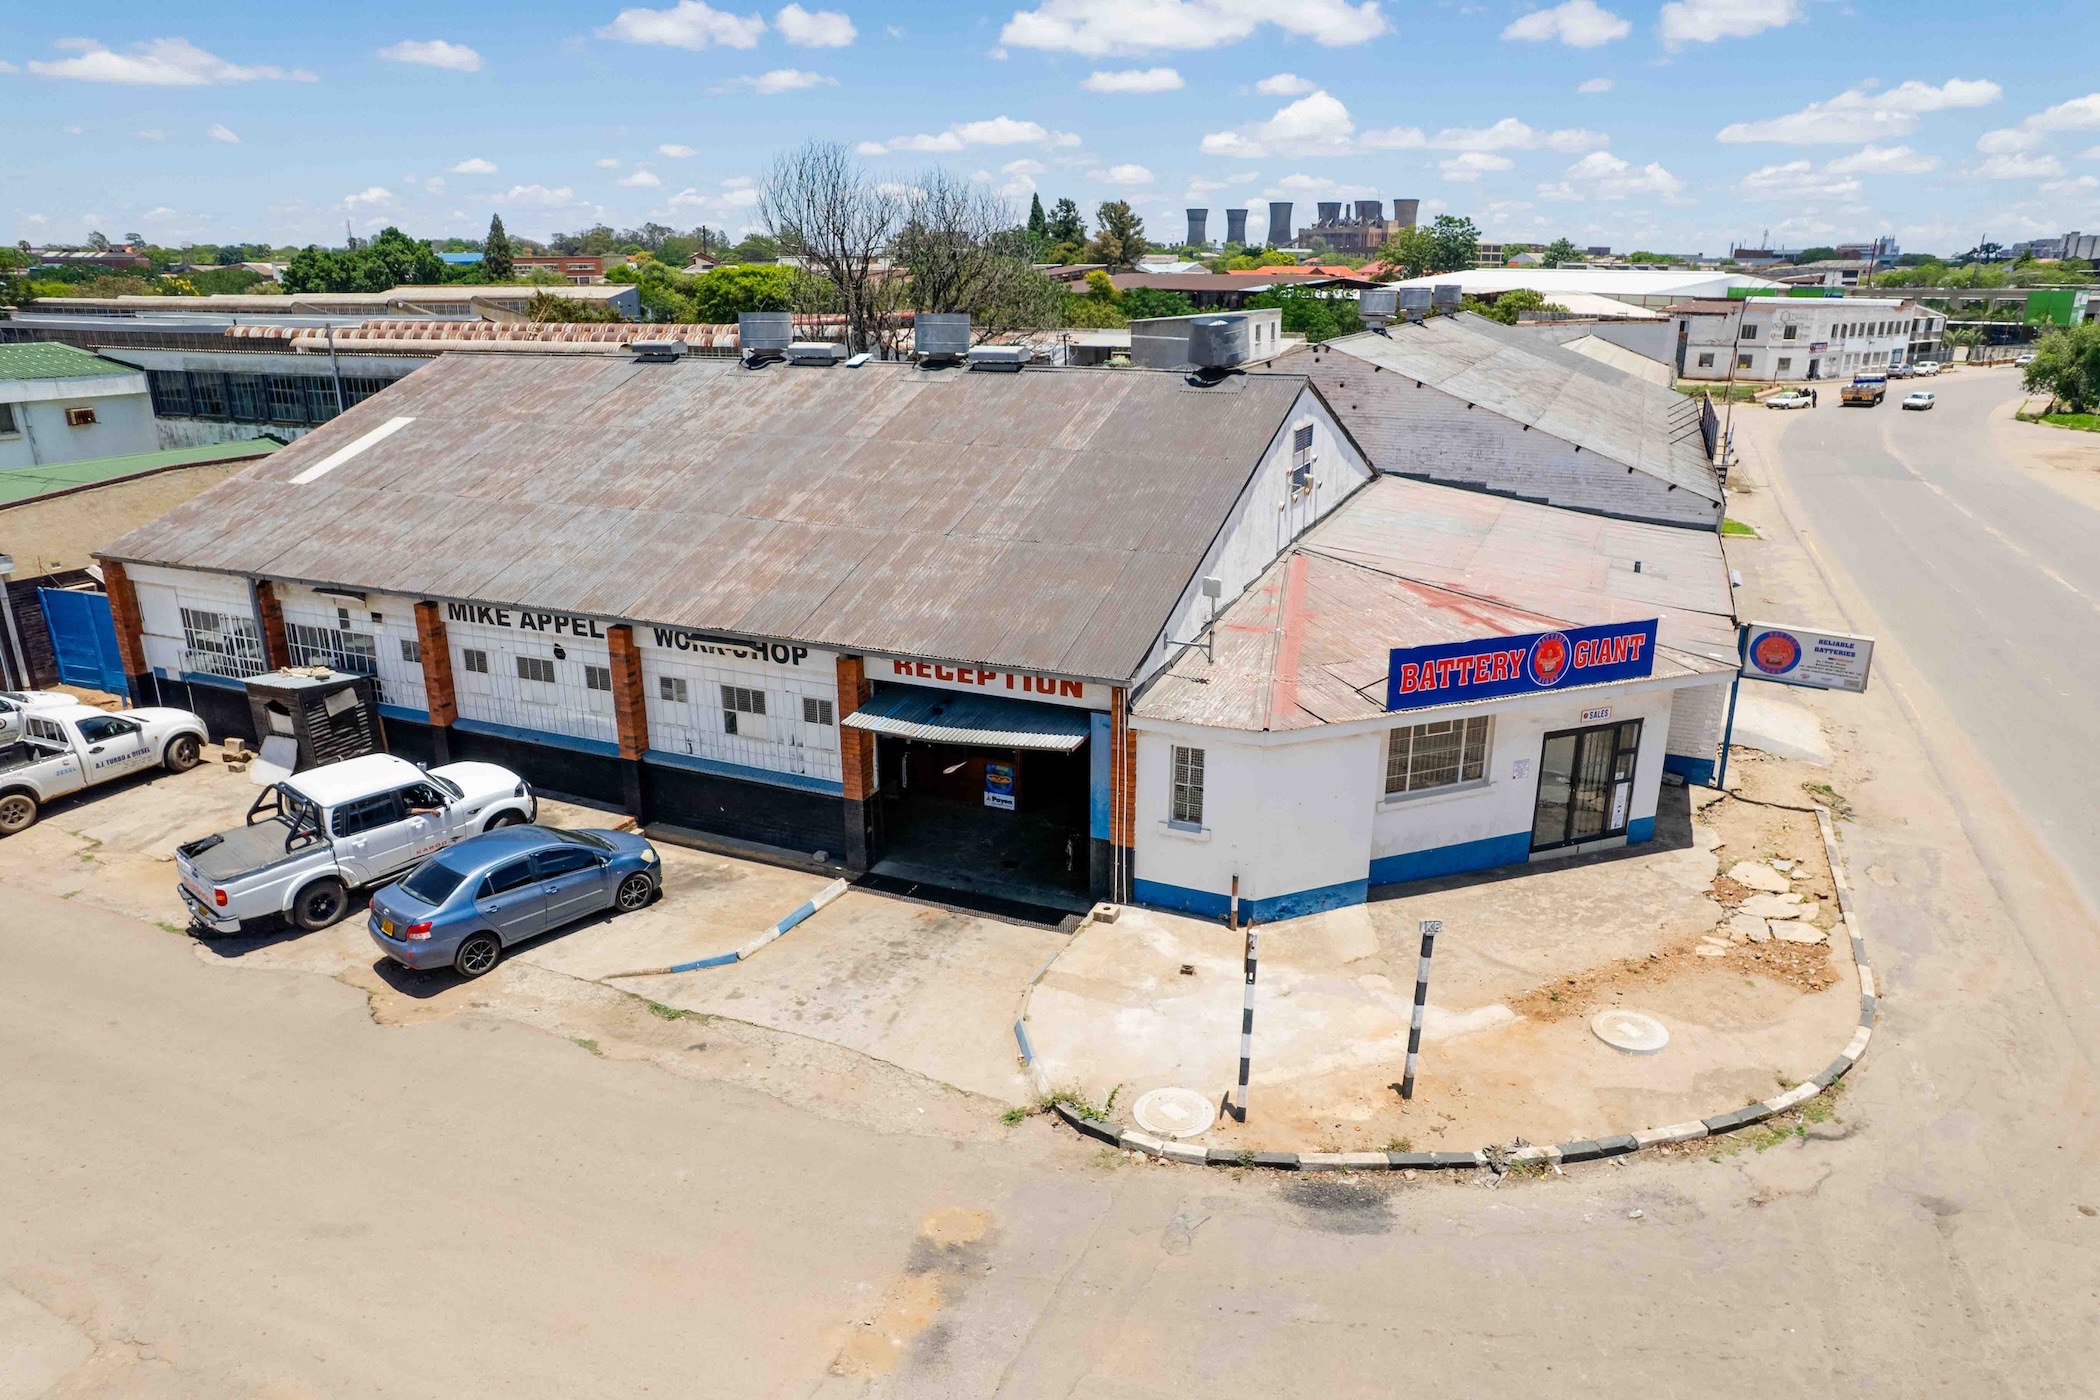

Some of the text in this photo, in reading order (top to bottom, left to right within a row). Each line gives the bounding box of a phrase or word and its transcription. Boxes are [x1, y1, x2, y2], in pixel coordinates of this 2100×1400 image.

[448, 603, 605, 639] MIKE APPEL
[1814, 646, 1856, 658] BATTERIES
[1818, 639, 1855, 649] RELIABLE
[1400, 633, 1646, 694] BATTERY GIANT
[1589, 709, 1609, 719] SALES
[106, 754, 126, 766] TURBO
[131, 746, 150, 757] DIESEL
